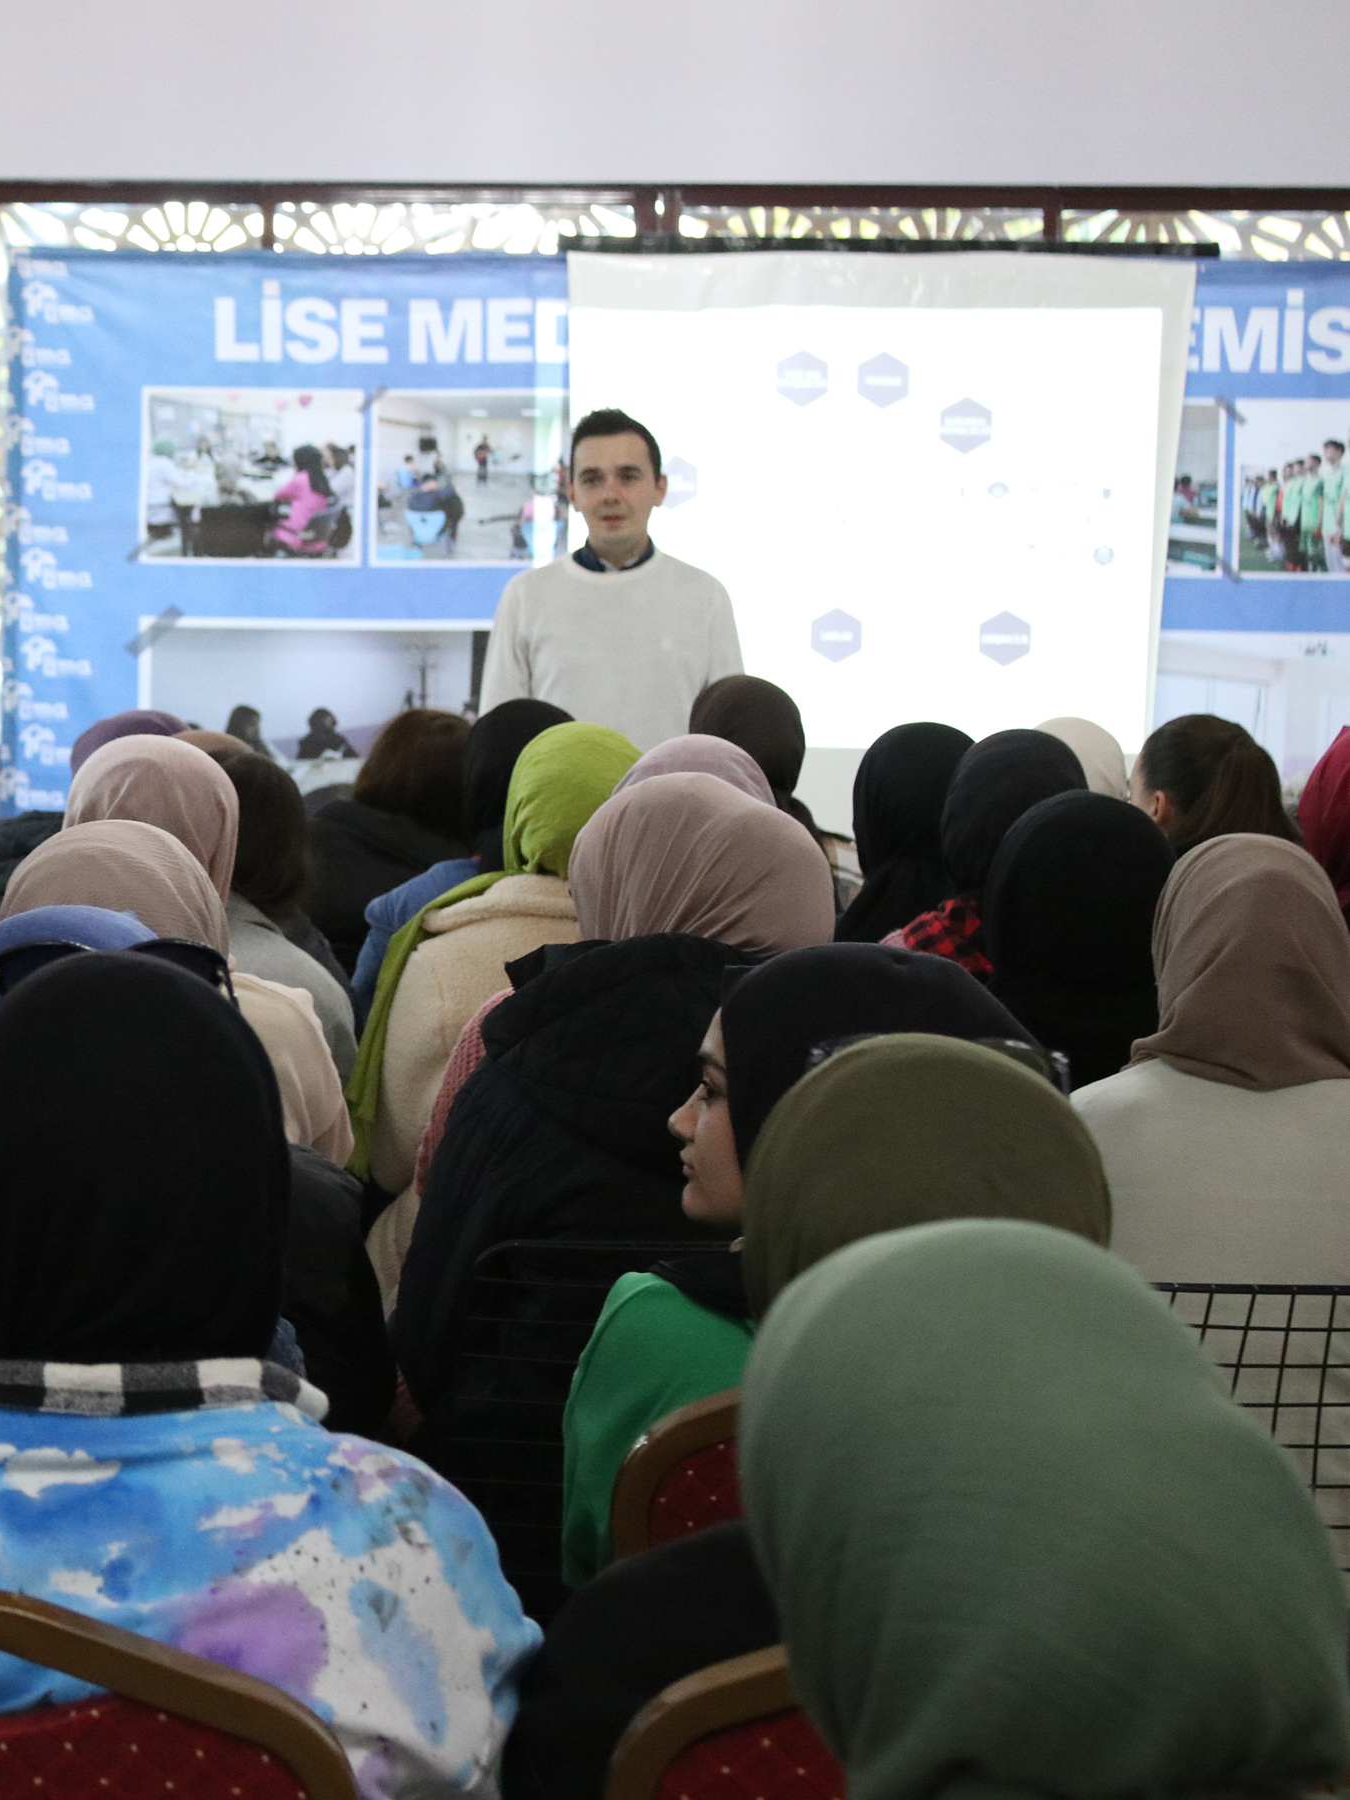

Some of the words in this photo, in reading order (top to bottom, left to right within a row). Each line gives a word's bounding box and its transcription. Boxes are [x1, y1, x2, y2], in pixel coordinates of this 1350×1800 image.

[214, 279, 389, 364] LİSE
[408, 297, 567, 364] MED
[1187, 288, 1350, 374] MİS
